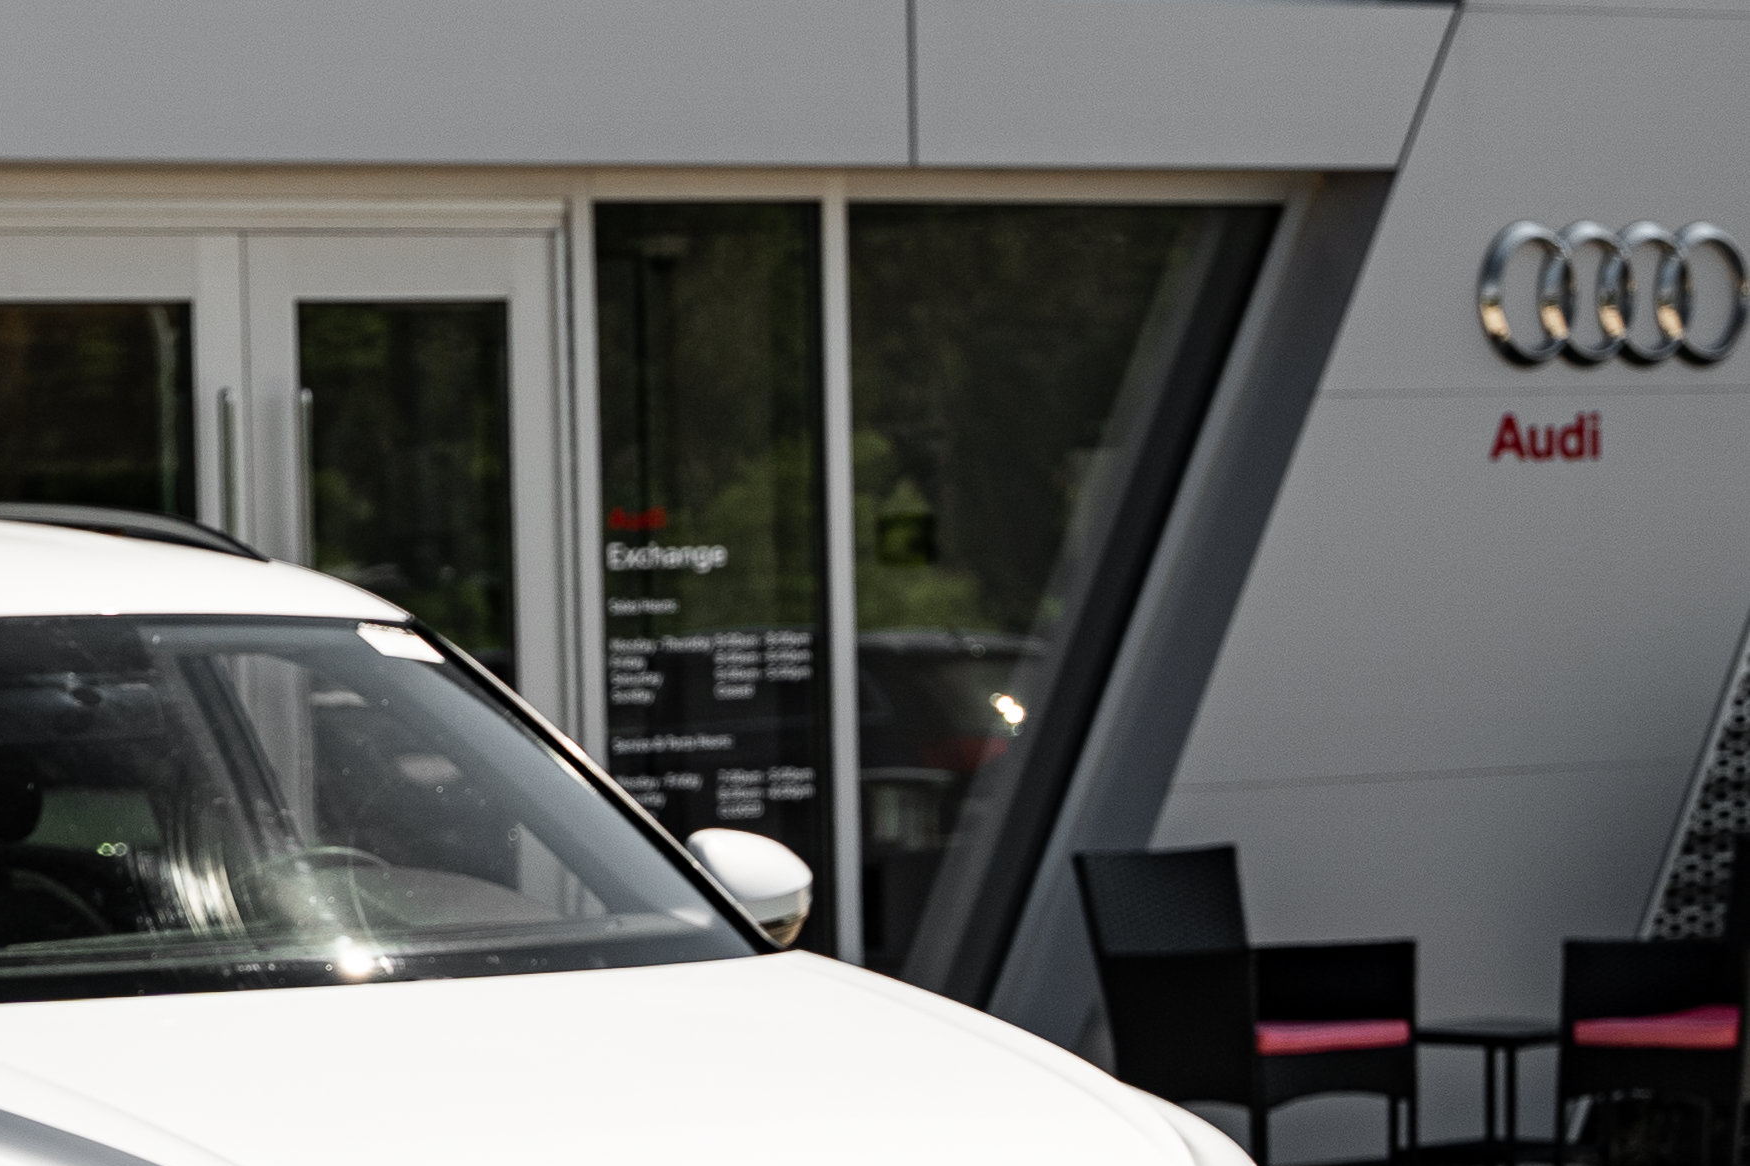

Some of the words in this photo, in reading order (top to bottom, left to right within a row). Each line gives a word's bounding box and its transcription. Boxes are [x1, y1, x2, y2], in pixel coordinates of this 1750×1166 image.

[1490, 411, 1603, 462] Audi
[608, 506, 668, 531] Audi
[606, 541, 728, 572] Exchange
